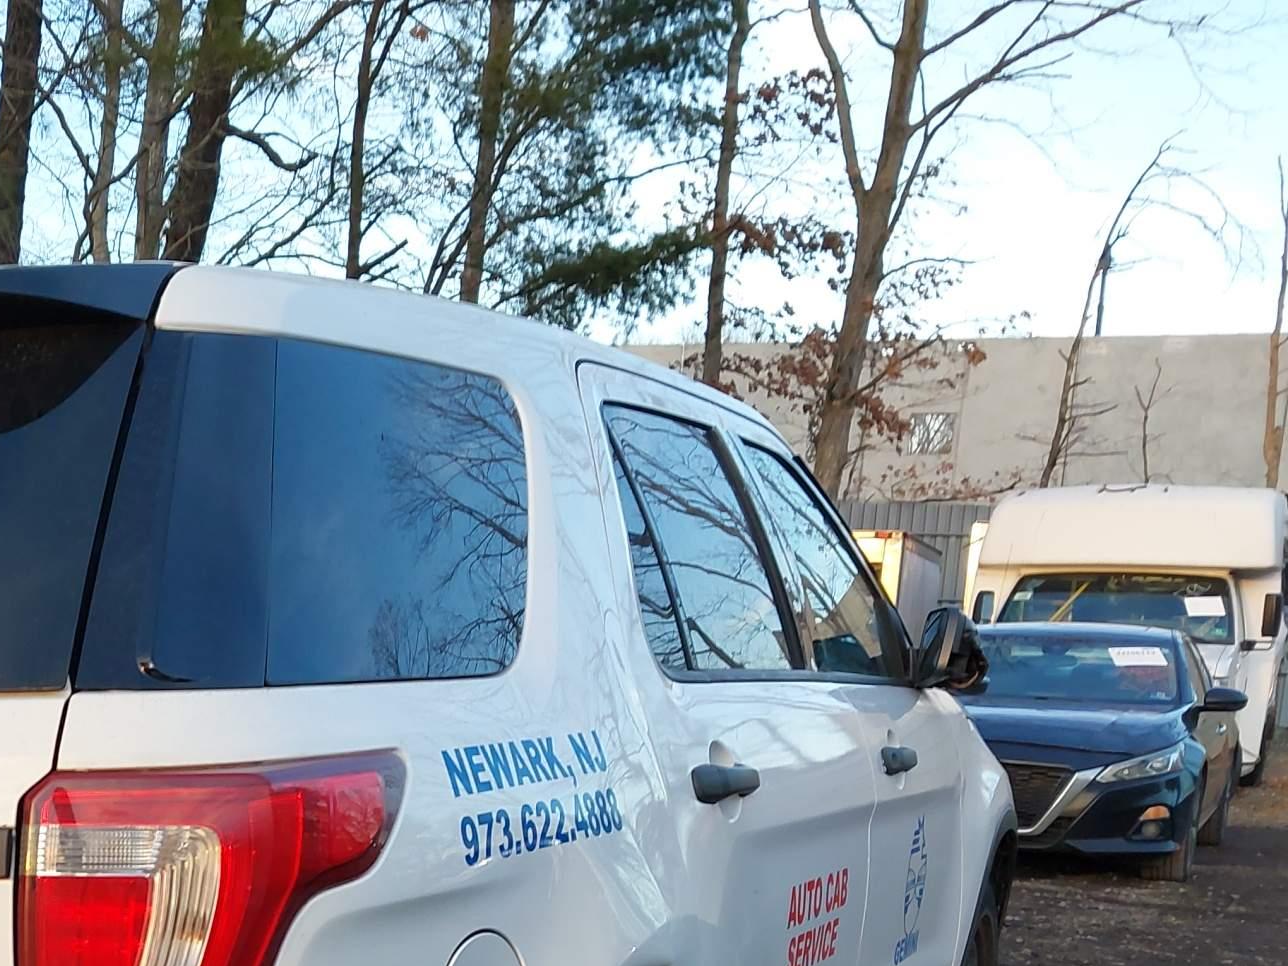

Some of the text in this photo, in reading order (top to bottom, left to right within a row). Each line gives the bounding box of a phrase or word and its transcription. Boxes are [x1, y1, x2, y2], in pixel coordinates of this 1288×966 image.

[441, 730, 608, 797] NEWARK, NJ
[460, 788, 623, 867] 973.622.4888
[787, 868, 849, 930] AUTO CAB
